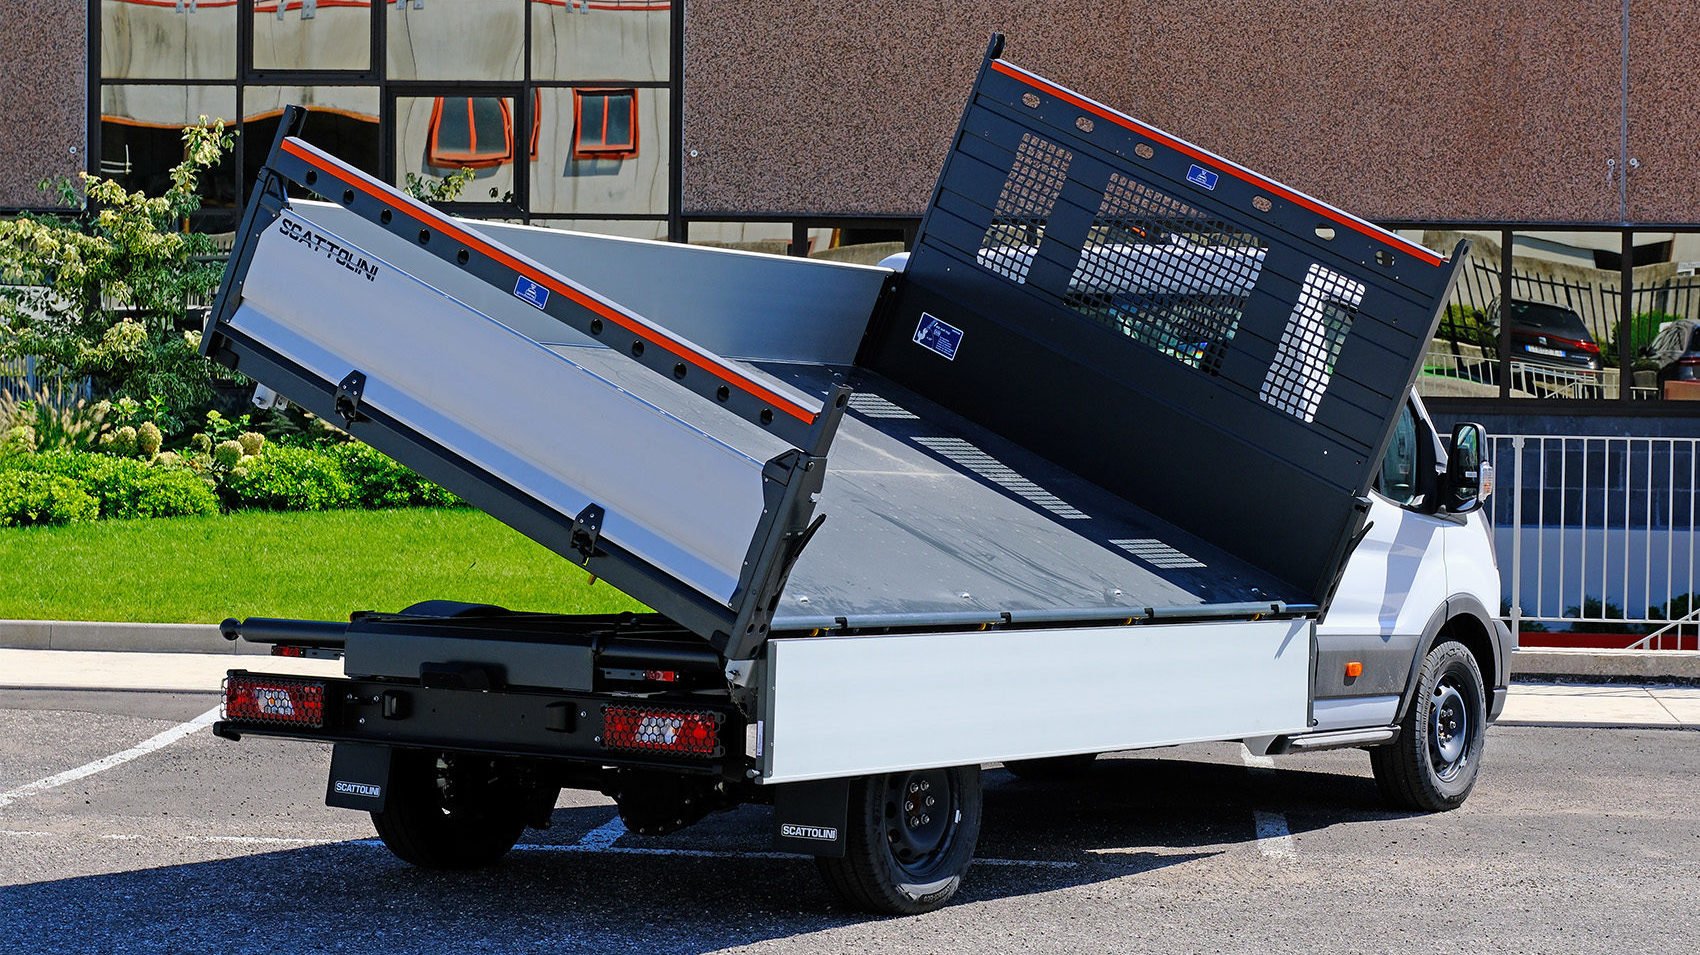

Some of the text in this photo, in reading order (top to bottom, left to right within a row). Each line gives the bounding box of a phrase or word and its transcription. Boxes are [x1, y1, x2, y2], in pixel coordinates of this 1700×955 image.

[279, 218, 379, 282] SCATTOLINI
[336, 782, 380, 796] SCATTOLINI
[783, 825, 836, 839] SCATTOLINI
